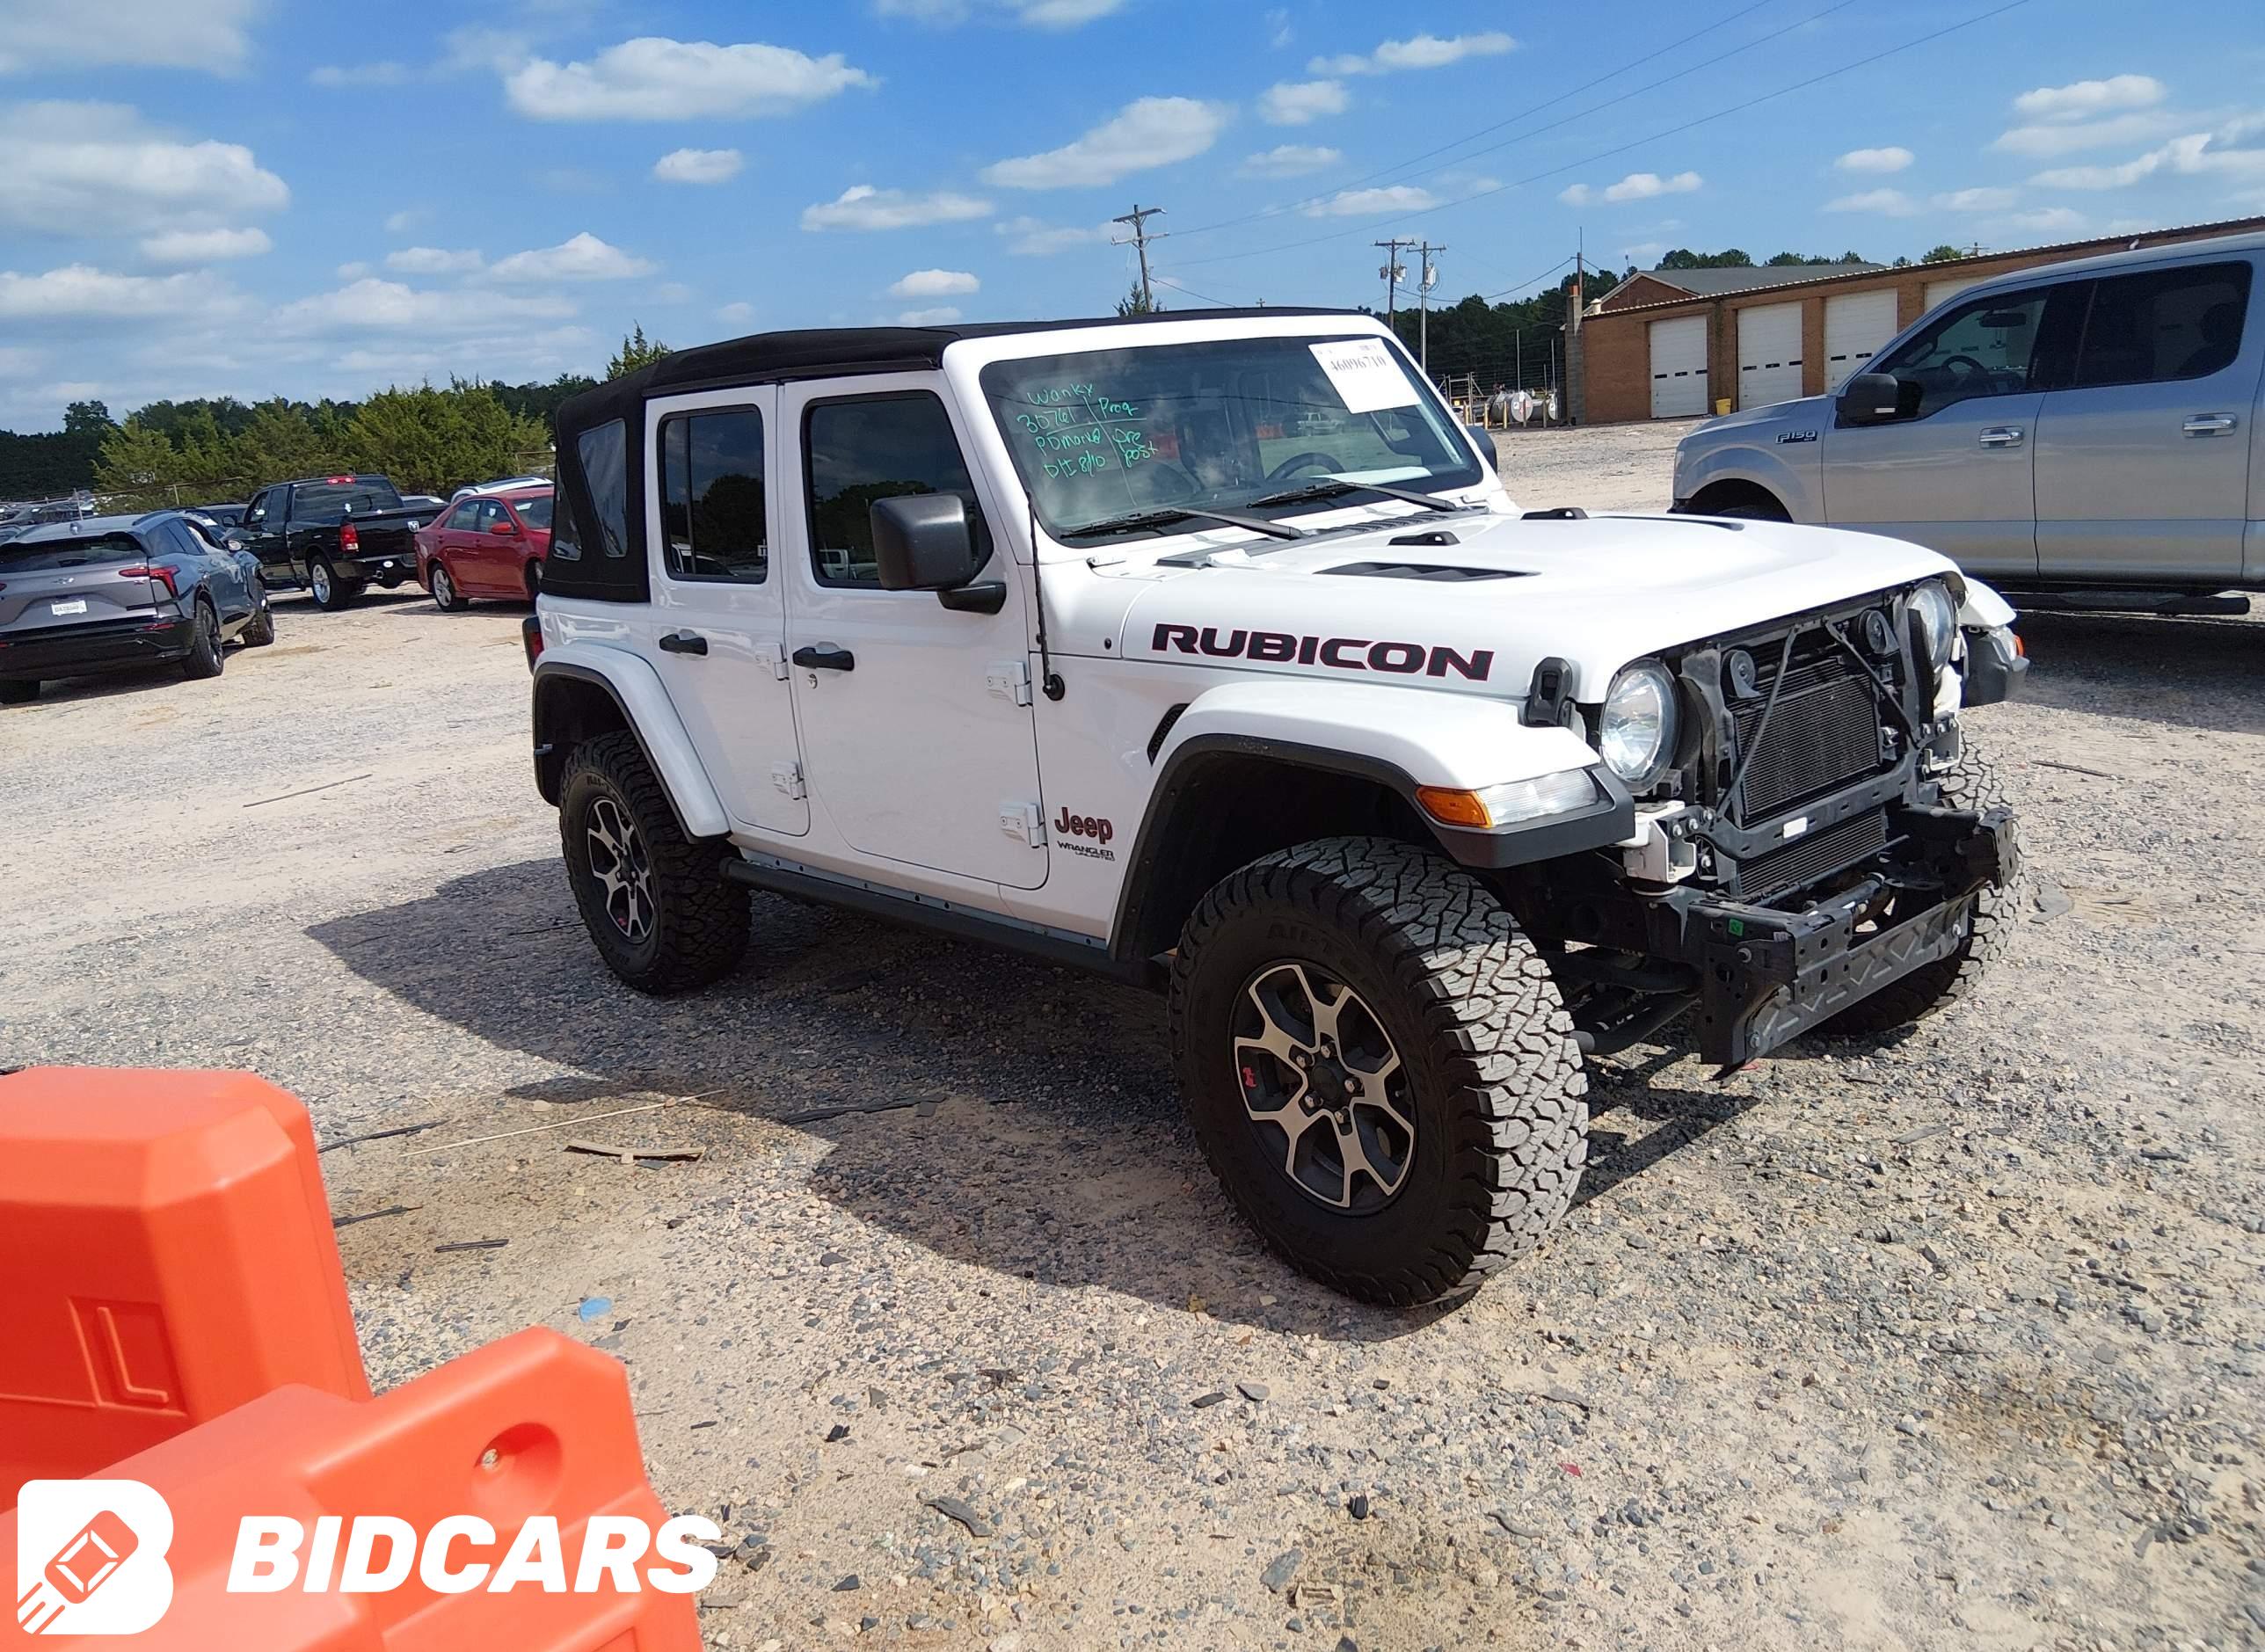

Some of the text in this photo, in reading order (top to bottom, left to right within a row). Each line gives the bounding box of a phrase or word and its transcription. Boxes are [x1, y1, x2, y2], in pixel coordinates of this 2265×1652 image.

[1151, 622, 1495, 682] RUBICON
[1054, 806, 1113, 845] Jeep
[1057, 840, 1114, 859] WRANGLER
